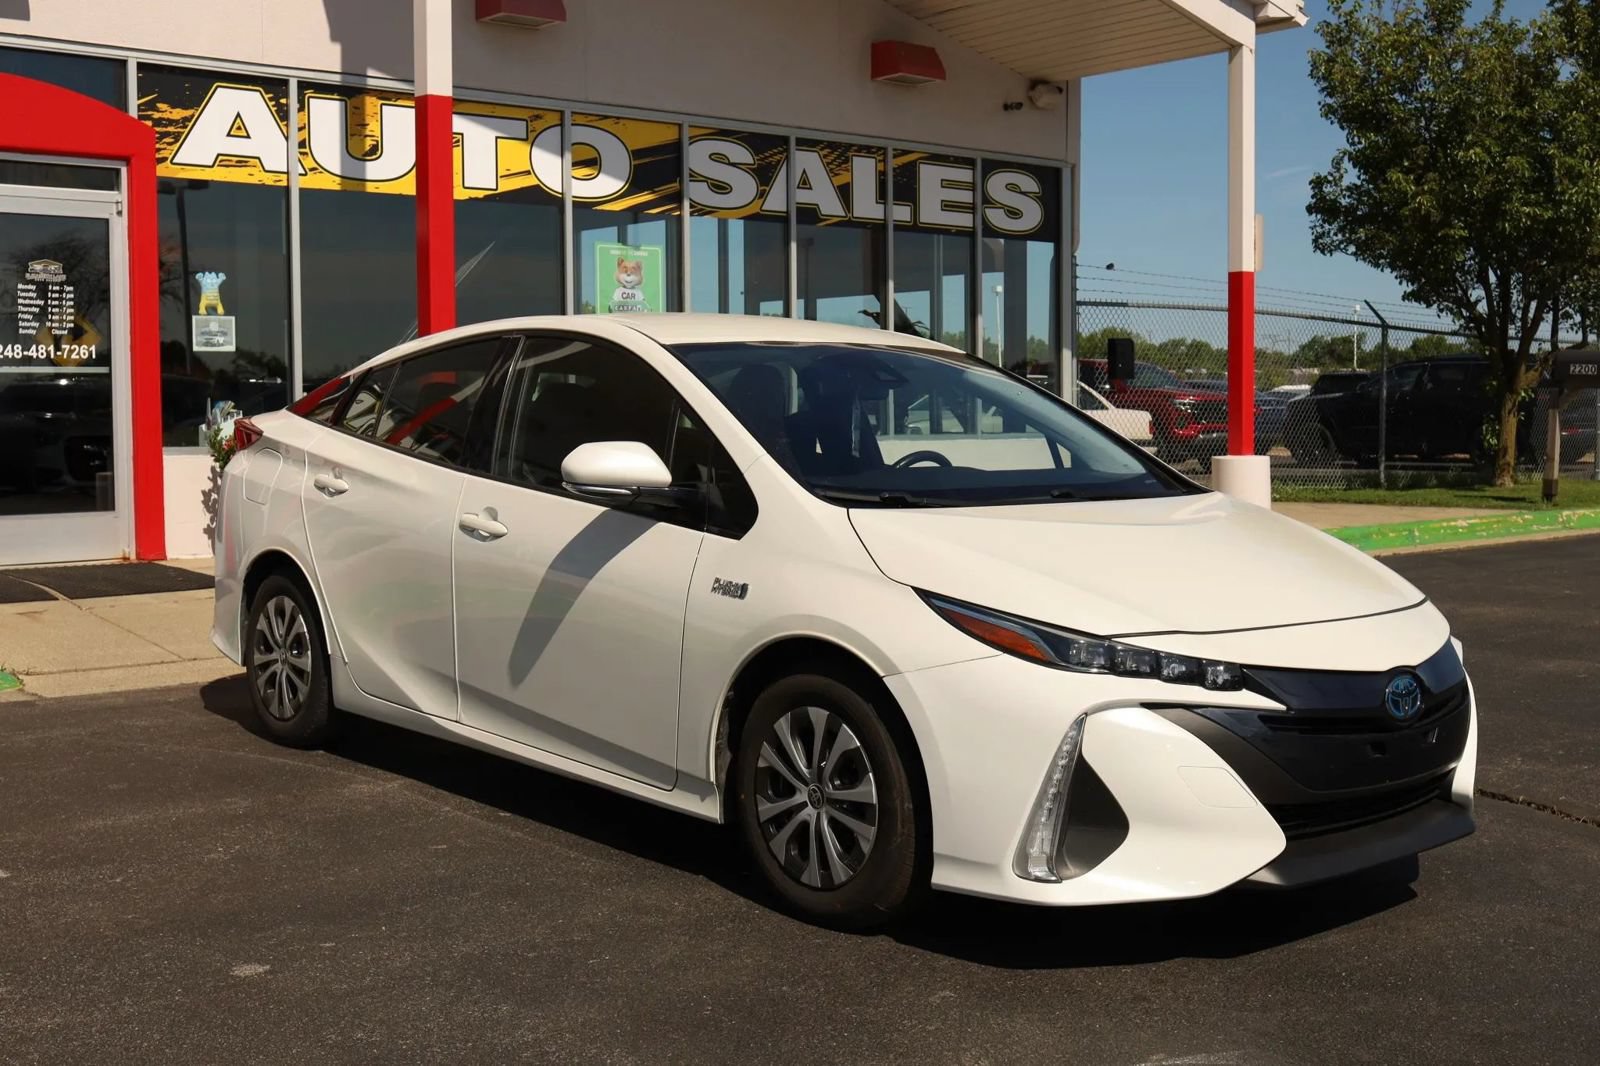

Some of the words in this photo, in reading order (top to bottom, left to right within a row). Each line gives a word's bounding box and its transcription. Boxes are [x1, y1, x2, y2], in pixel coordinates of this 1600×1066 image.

[170, 82, 633, 199] AUTO
[680, 136, 1043, 234] SALES
[17, 283, 36, 291] Monday
[621, 292, 636, 300] CAR
[18, 312, 34, 320] Friday
[1570, 364, 1597, 375] 2200
